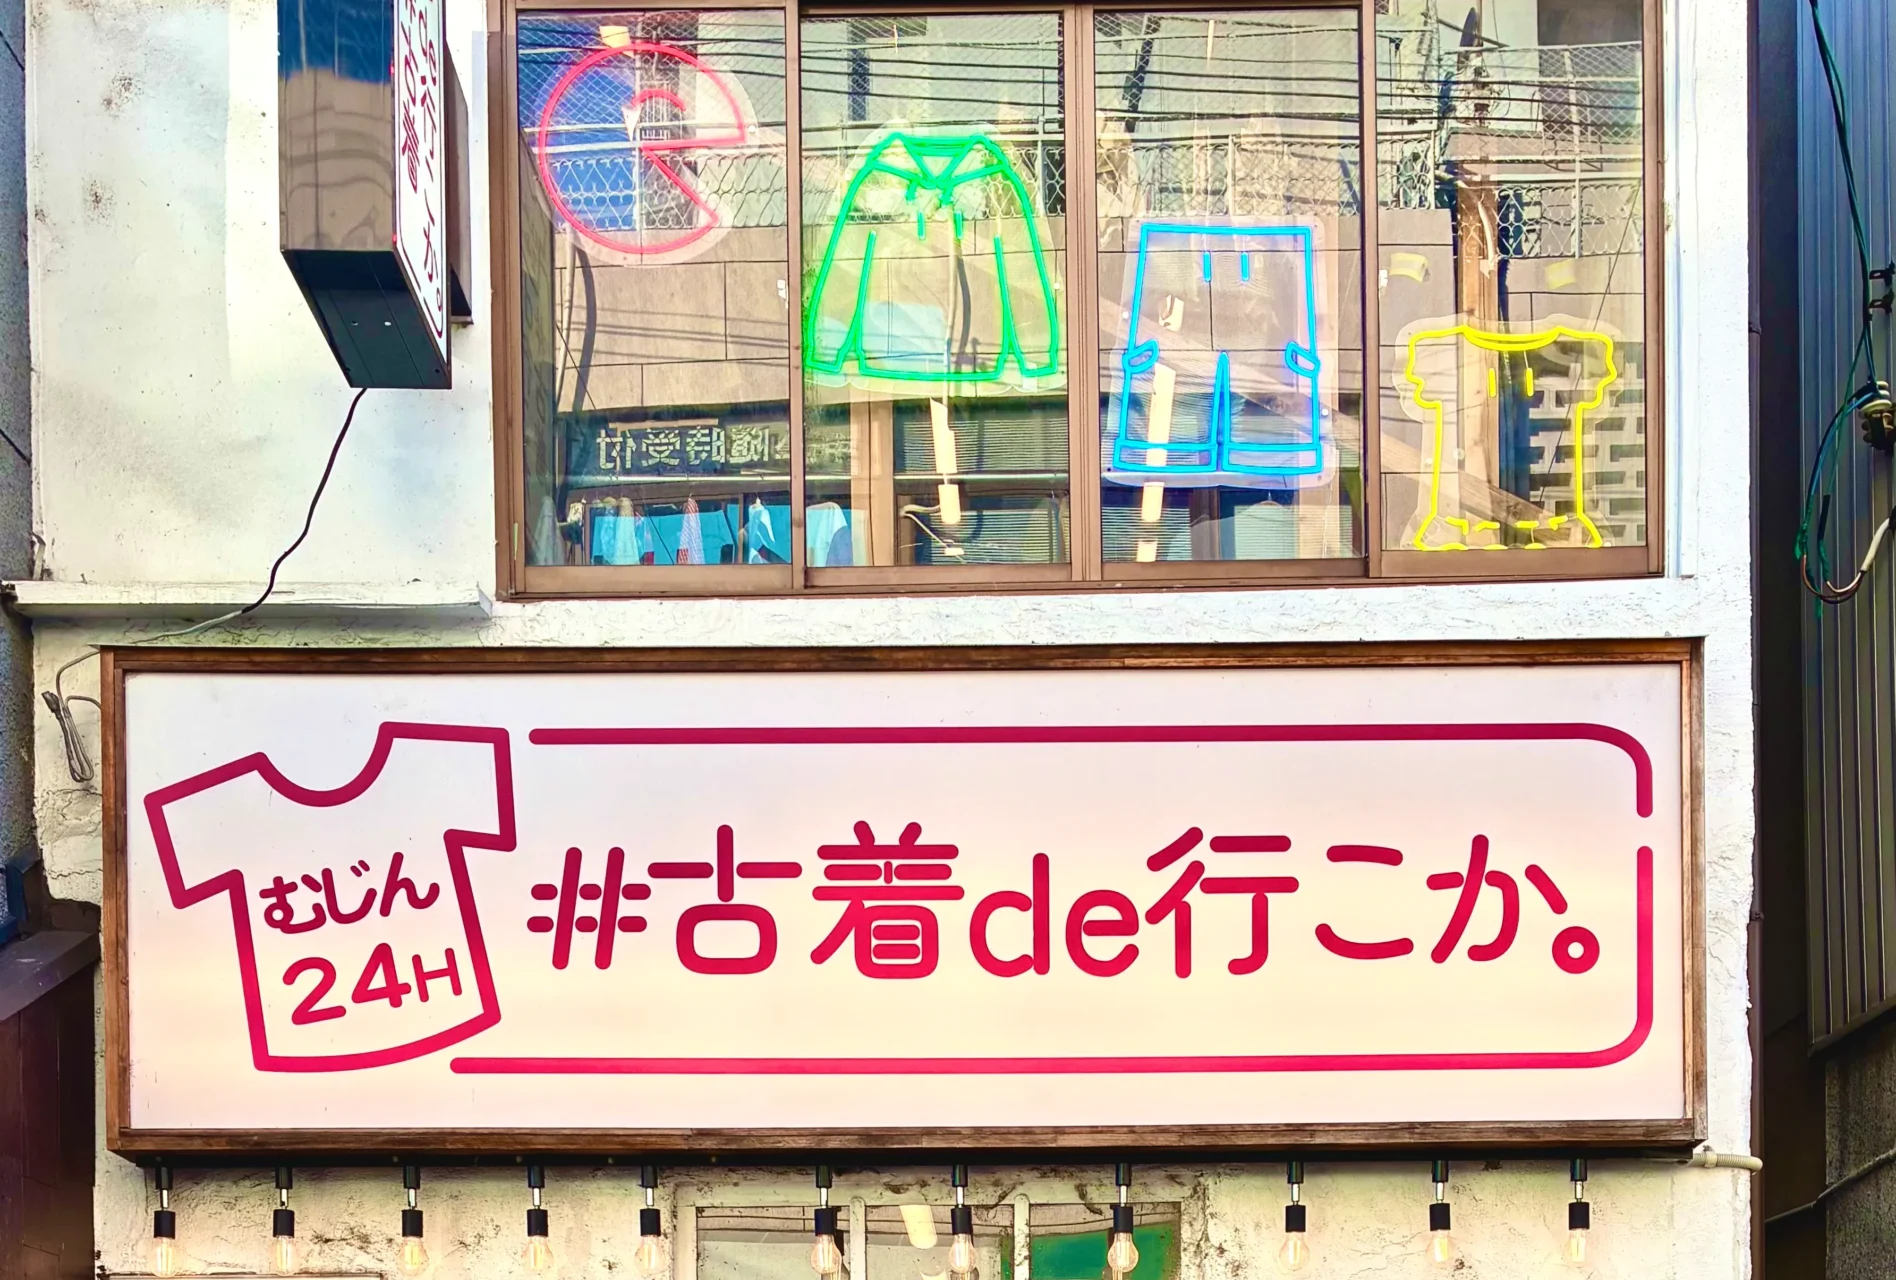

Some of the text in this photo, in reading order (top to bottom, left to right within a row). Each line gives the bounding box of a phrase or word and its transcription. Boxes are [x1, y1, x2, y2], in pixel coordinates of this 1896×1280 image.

[258, 851, 440, 935] むじん
[526, 820, 1600, 980] #古着de行こか。
[282, 942, 463, 1026] 24H
